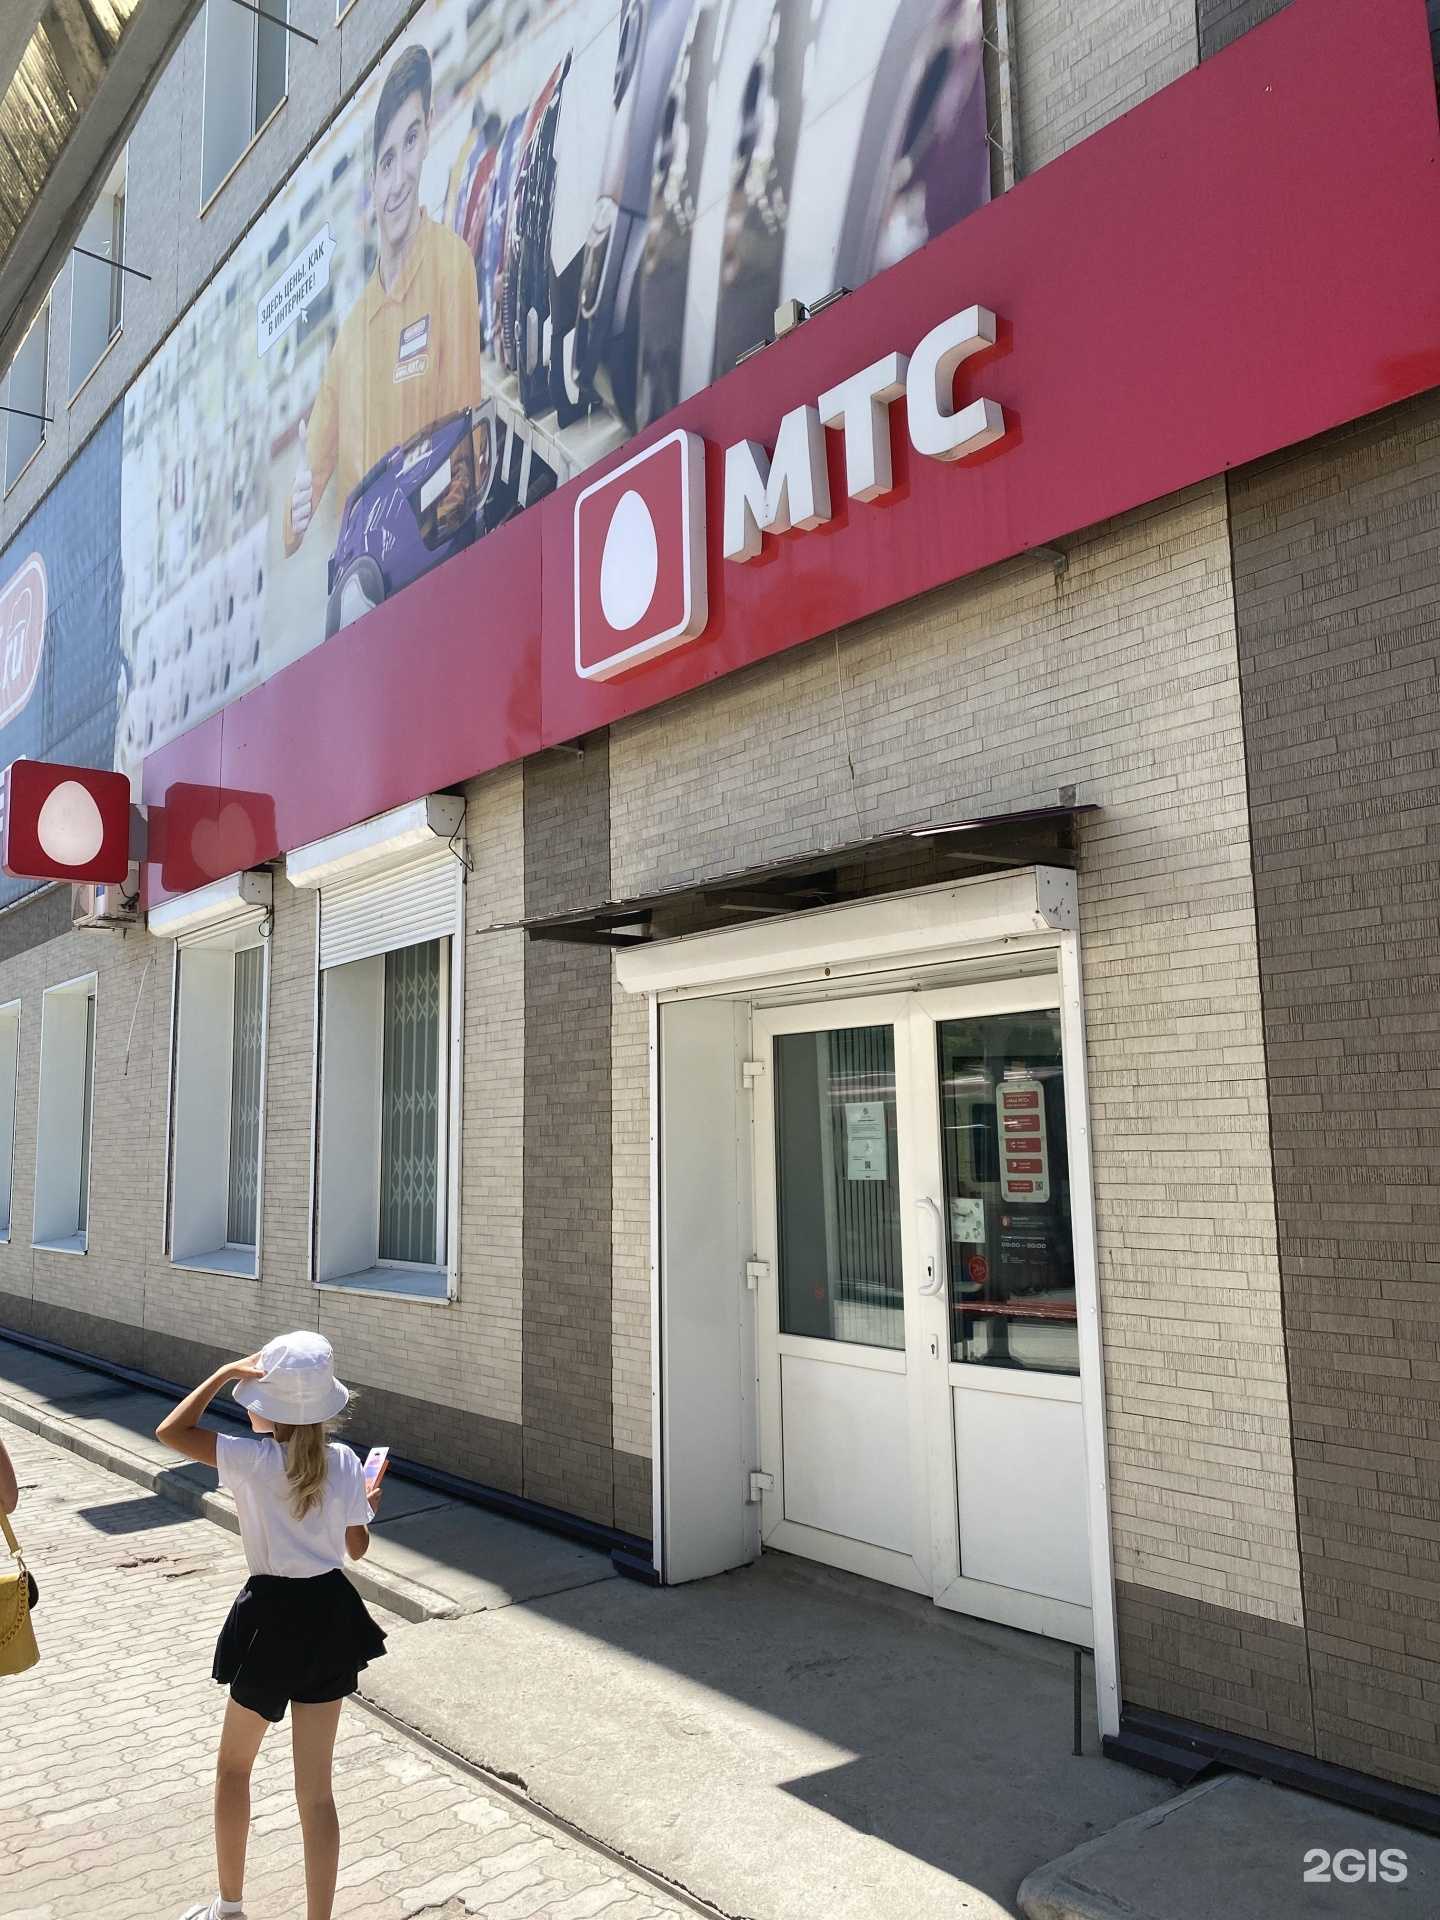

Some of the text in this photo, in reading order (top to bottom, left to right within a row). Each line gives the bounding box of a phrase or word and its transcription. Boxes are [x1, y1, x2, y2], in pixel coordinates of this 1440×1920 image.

[261, 241, 324, 324] ЗДЕСЬ ЦЕНЫ, КАК
[268, 271, 316, 336] В ИНТЕРНЕТЕ!
[723, 304, 1006, 564] МТС
